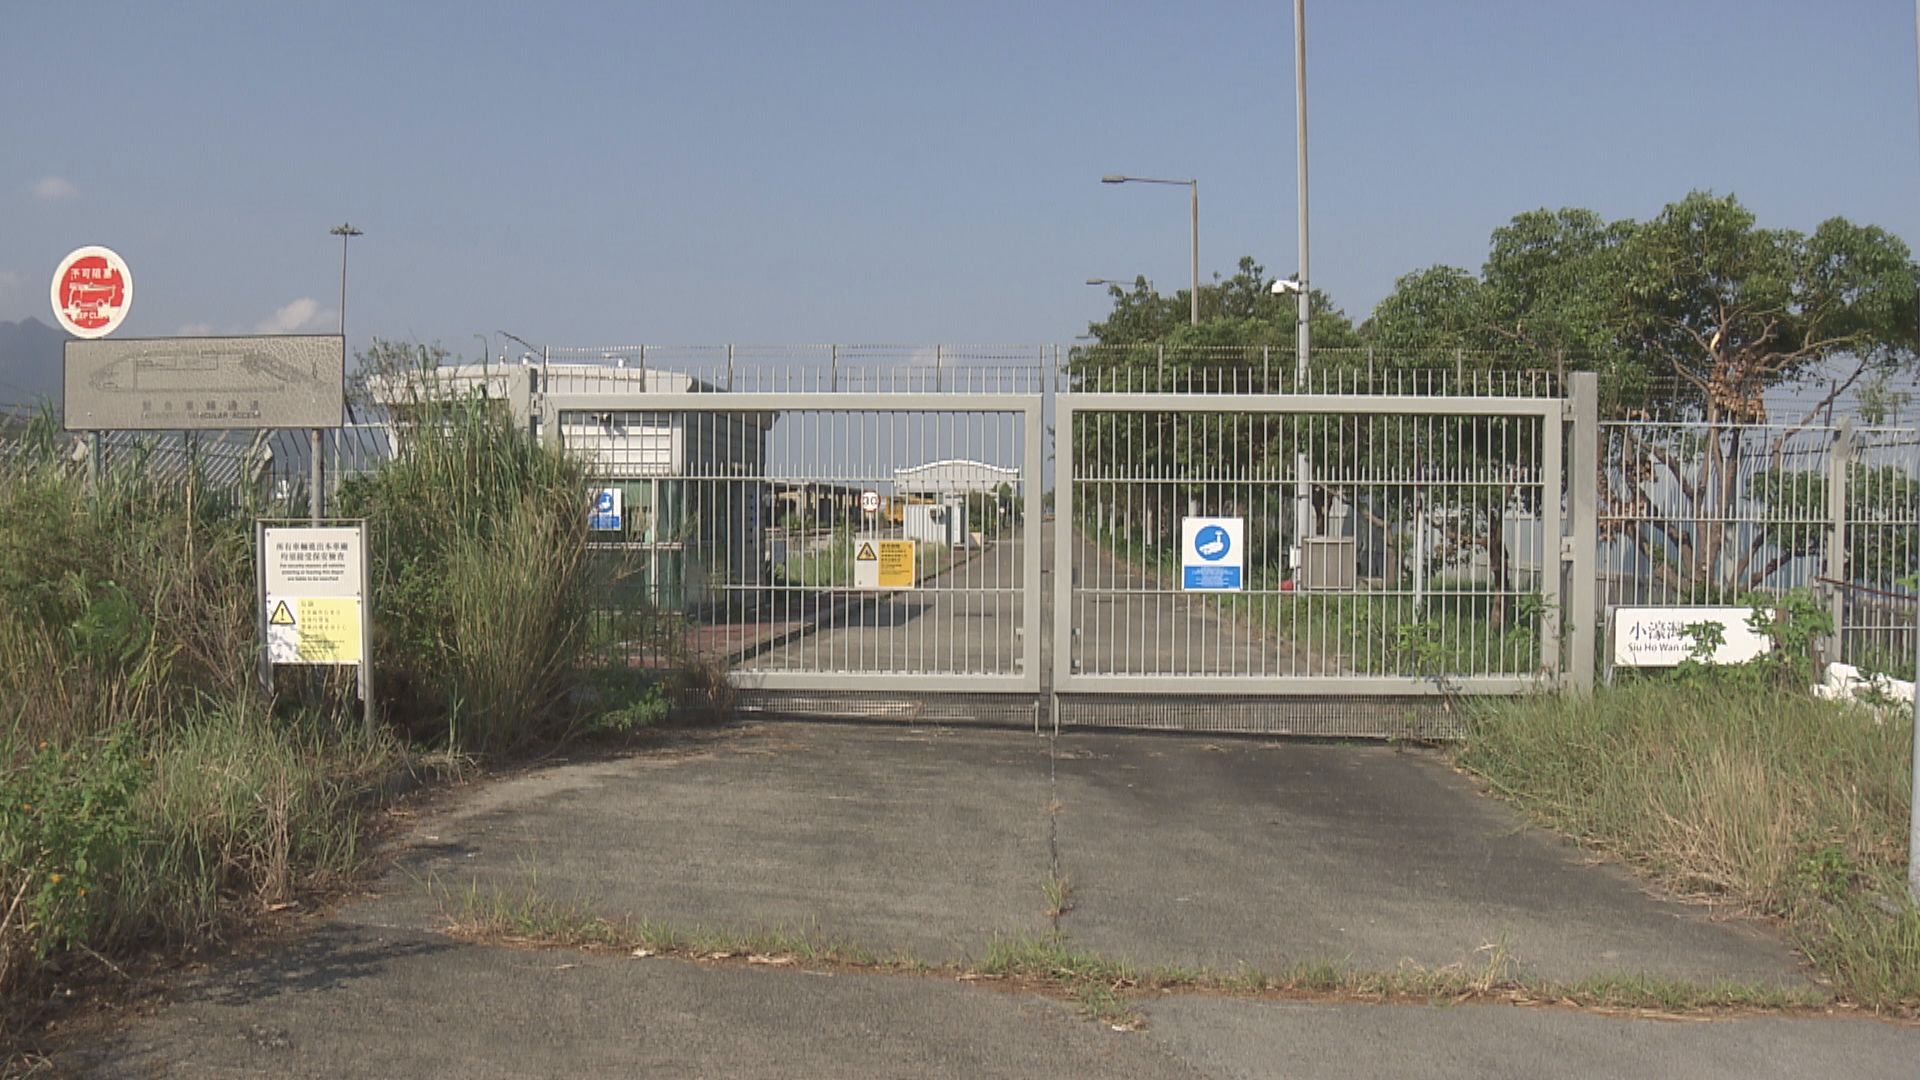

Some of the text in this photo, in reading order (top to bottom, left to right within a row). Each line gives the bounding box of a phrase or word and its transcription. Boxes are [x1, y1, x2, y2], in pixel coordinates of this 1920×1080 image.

[1628, 642, 1642, 652] Siu
[1645, 643, 1657, 652] Ho
[1659, 643, 1679, 652] Wan
